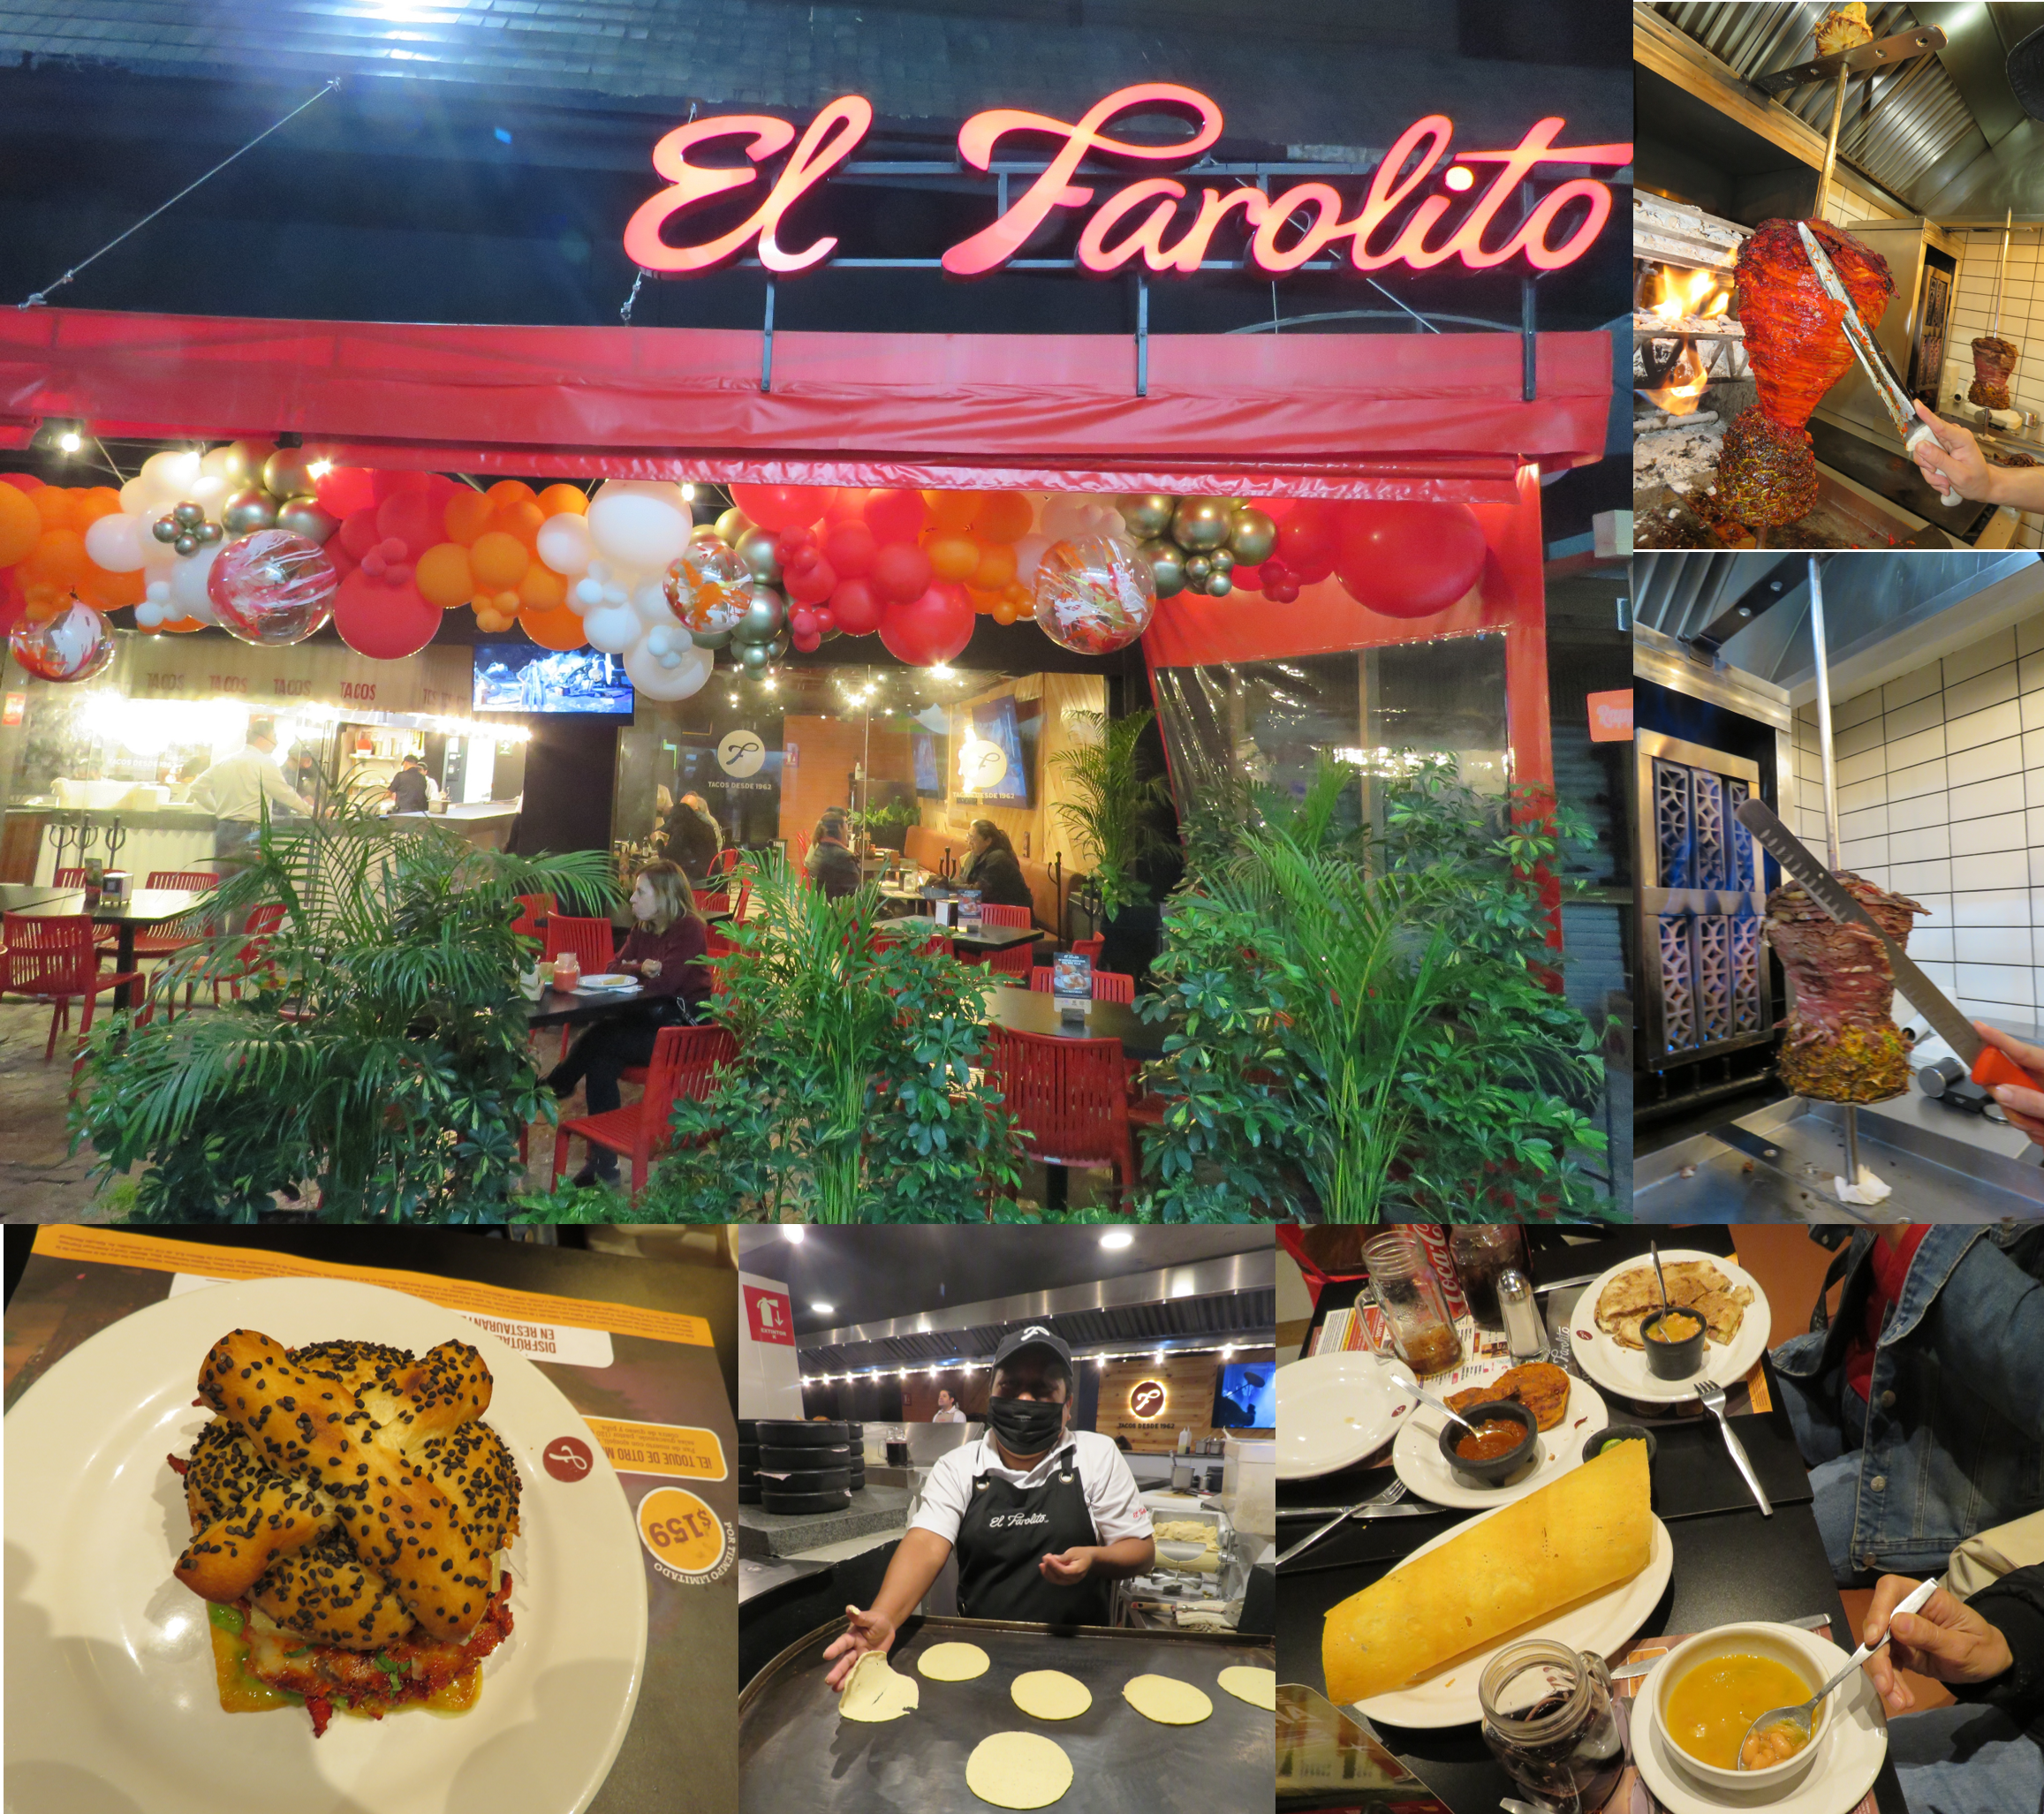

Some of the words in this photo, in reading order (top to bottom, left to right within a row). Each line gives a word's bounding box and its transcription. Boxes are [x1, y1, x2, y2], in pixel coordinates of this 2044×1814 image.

[623, 94, 873, 275] El
[941, 82, 1633, 276] Farolito
[208, 675, 248, 694] TACOS
[274, 677, 312, 697] TACOS
[340, 681, 377, 701] TACOS
[459, 1314, 538, 1339] RESTAURAN
[540, 1327, 555, 1341] EN
[760, 1327, 787, 1337] EXTINTOR
[1550, 1326, 1571, 1363] Farolito
[602, 1447, 615, 1460] M
[617, 1447, 645, 1463] OTRO
[646, 1442, 670, 1451] muerto
[646, 1450, 661, 1464] DE
[663, 1452, 696, 1468] TOQUE
[648, 1508, 712, 1548] $159
[989, 1515, 1003, 1528] El
[1008, 1512, 1047, 1527] Farolito
[723, 1521, 736, 1545] POR
[710, 1545, 736, 1580] TIEMPO
[654, 1562, 712, 1584] LIMITADO
